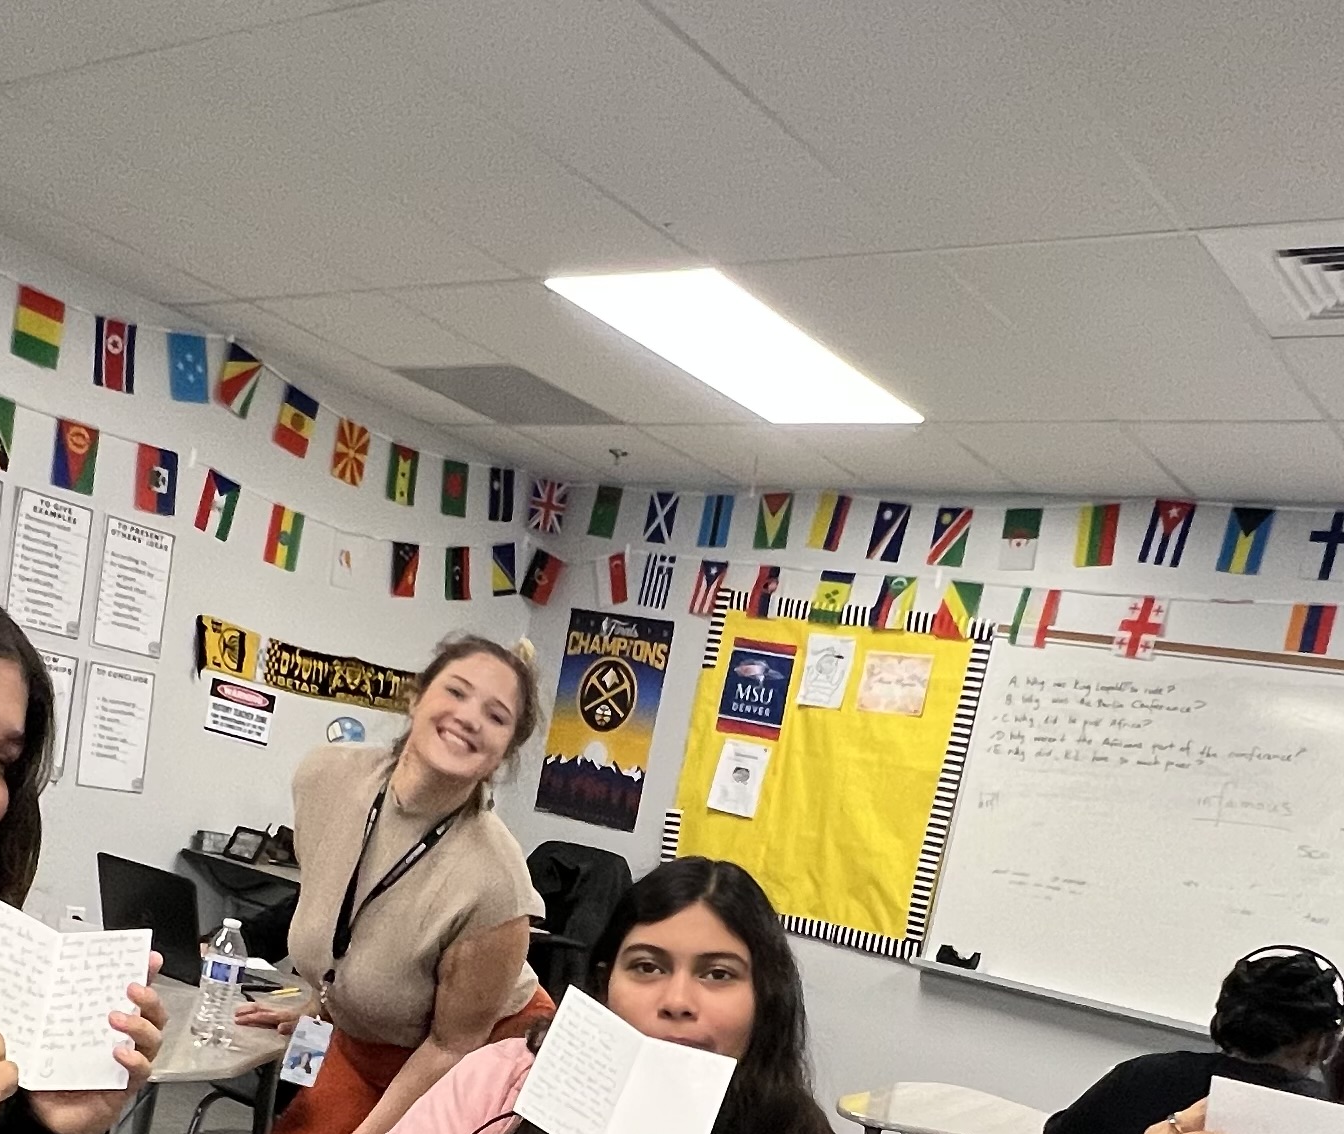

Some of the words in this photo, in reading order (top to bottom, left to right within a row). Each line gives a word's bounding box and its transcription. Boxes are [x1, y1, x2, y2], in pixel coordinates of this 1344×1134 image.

[32, 505, 77, 525] EXAMPLES
[567, 631, 668, 671] CHAMPIONS
[277, 675, 320, 694] BETAR
[734, 683, 774, 705] MSU
[731, 702, 772, 717] DENVER
